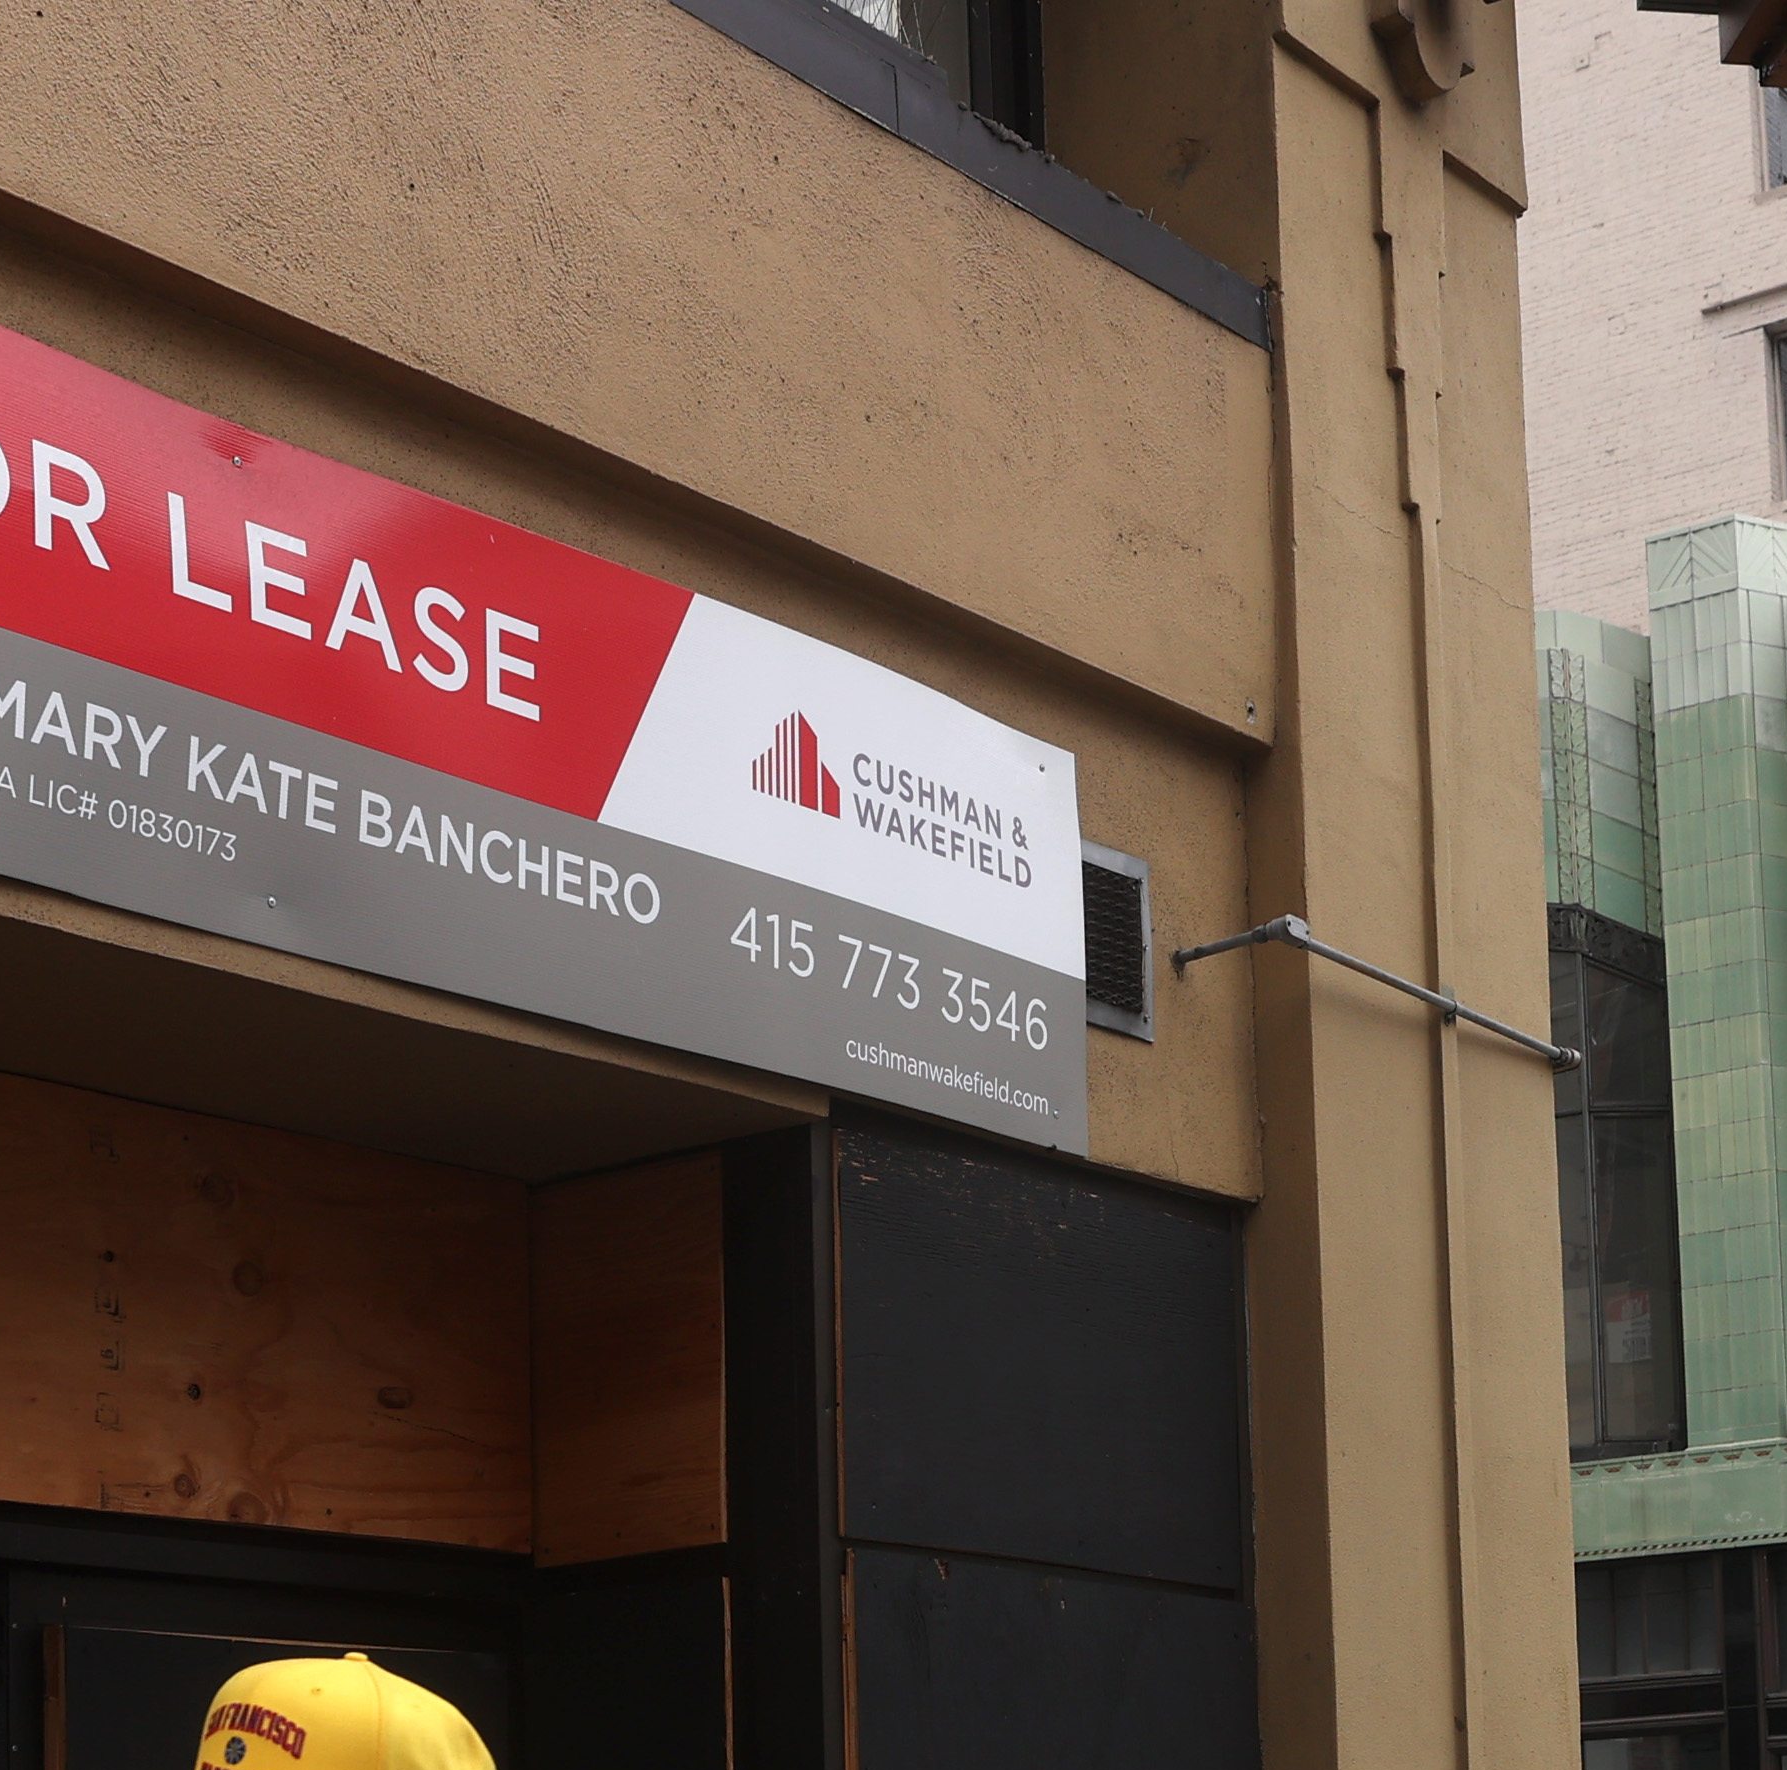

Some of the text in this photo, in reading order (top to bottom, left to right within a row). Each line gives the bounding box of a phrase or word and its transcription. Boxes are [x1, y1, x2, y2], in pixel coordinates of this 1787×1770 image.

[169, 492, 540, 722] LEASE
[28, 771, 99, 820] LIC#
[108, 798, 238, 863] 01830173
[188, 742, 337, 835] KATE
[359, 789, 661, 925] BANCHERO
[852, 752, 1029, 851] CUSHMAN &
[852, 792, 1032, 890] WAKEFIELD
[729, 906, 1048, 1051] 415 773 3546
[845, 1035, 1050, 1117] cushmanwakefield.com
[222, 1703, 306, 1759] FRANCISCO
